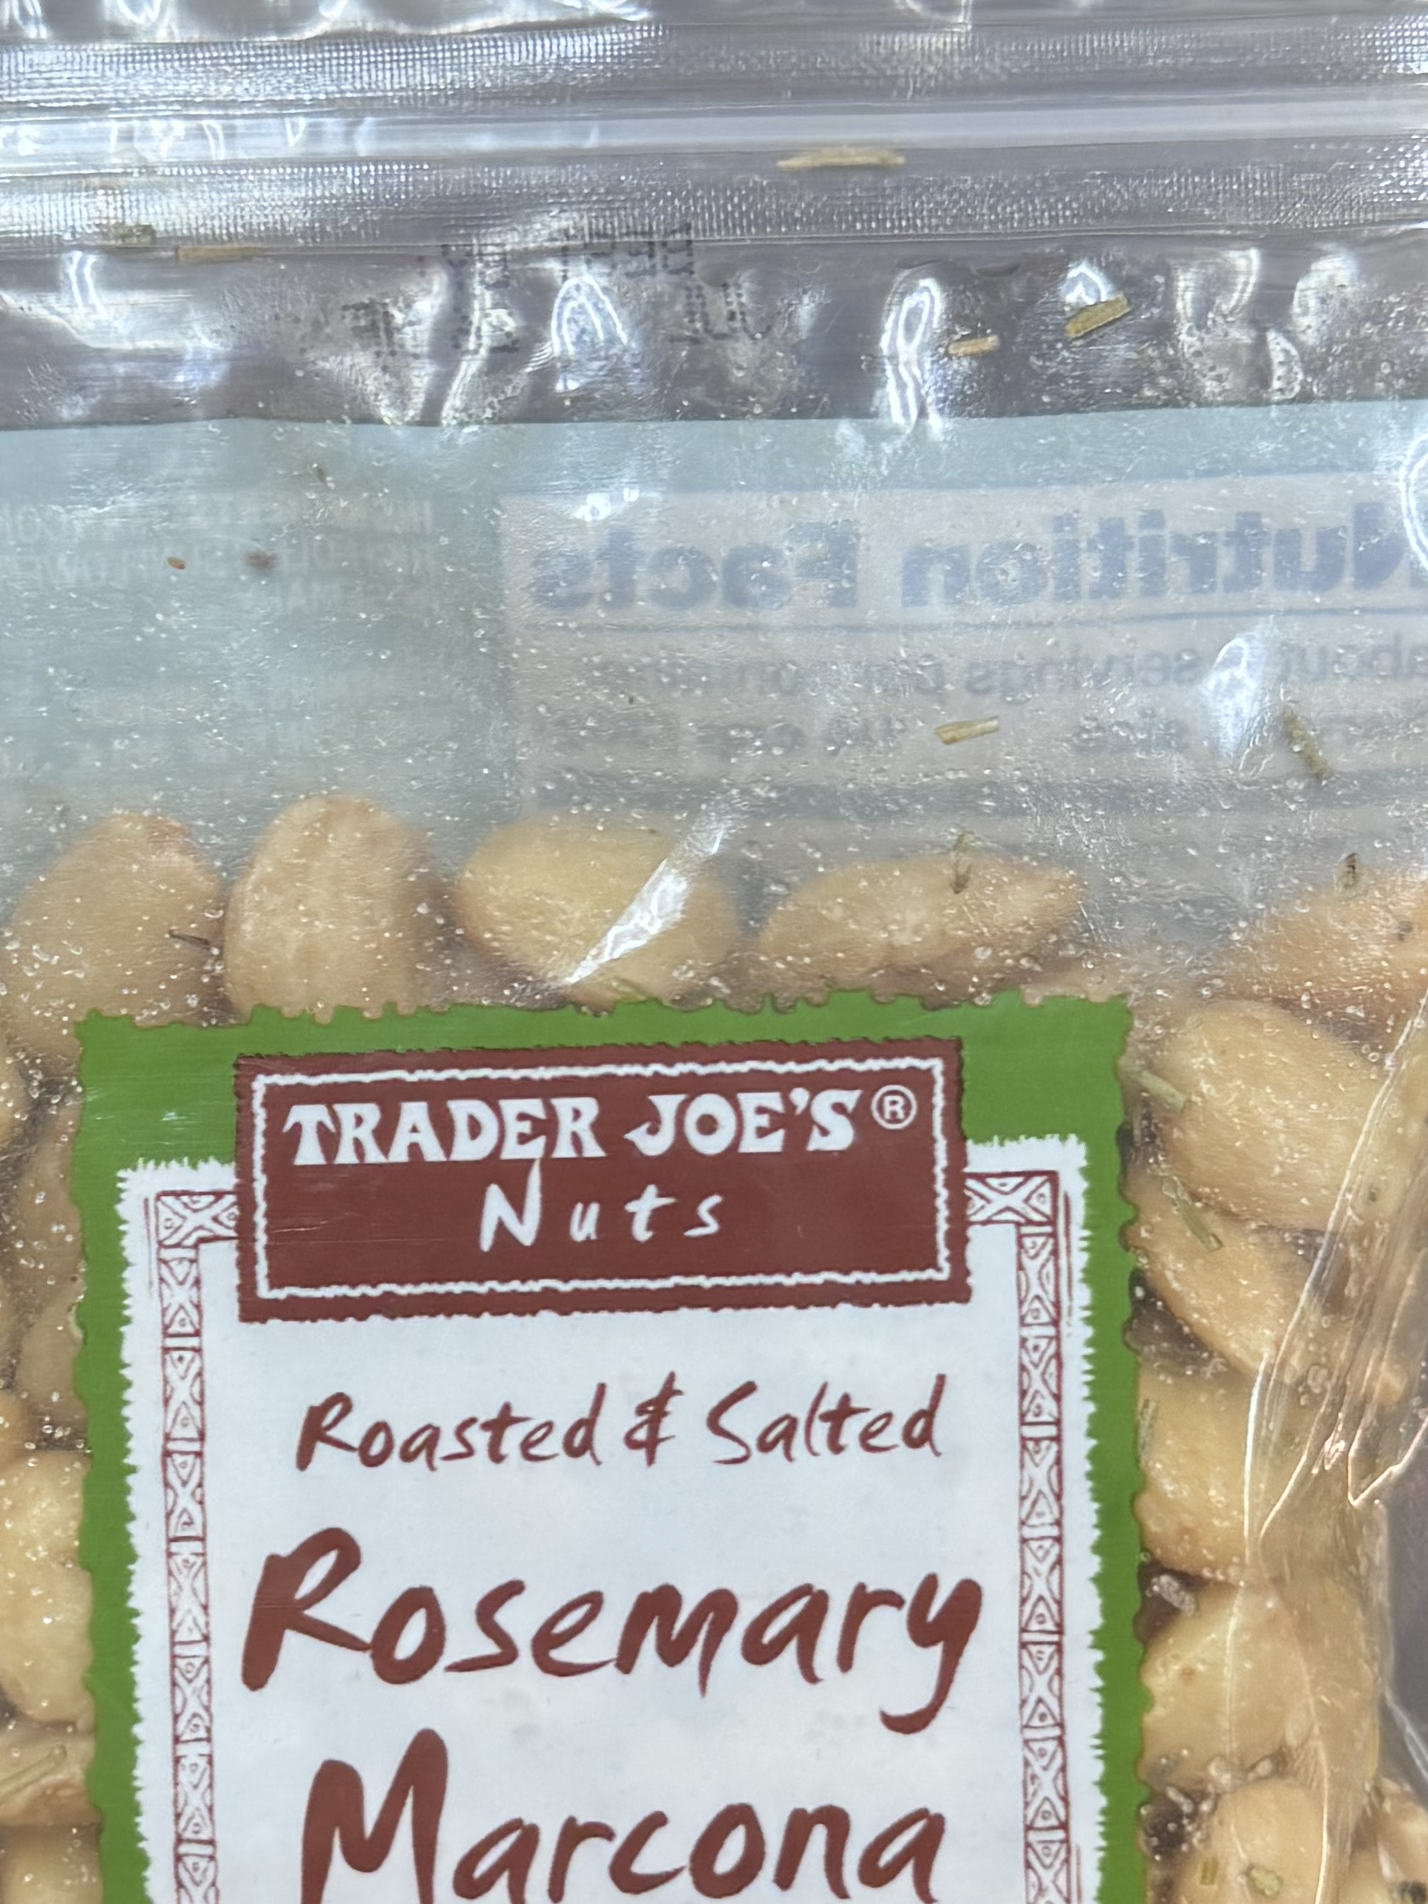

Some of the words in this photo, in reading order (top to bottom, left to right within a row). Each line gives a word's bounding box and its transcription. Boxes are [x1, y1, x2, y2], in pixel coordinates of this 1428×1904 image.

[281, 1095, 606, 1167] TRADER
[479, 1162, 724, 1253] Nuts
[295, 1382, 608, 1472] Roasted
[623, 1372, 682, 1467] &
[707, 1374, 948, 1465] Salted
[240, 1527, 984, 1735] Rosemary
